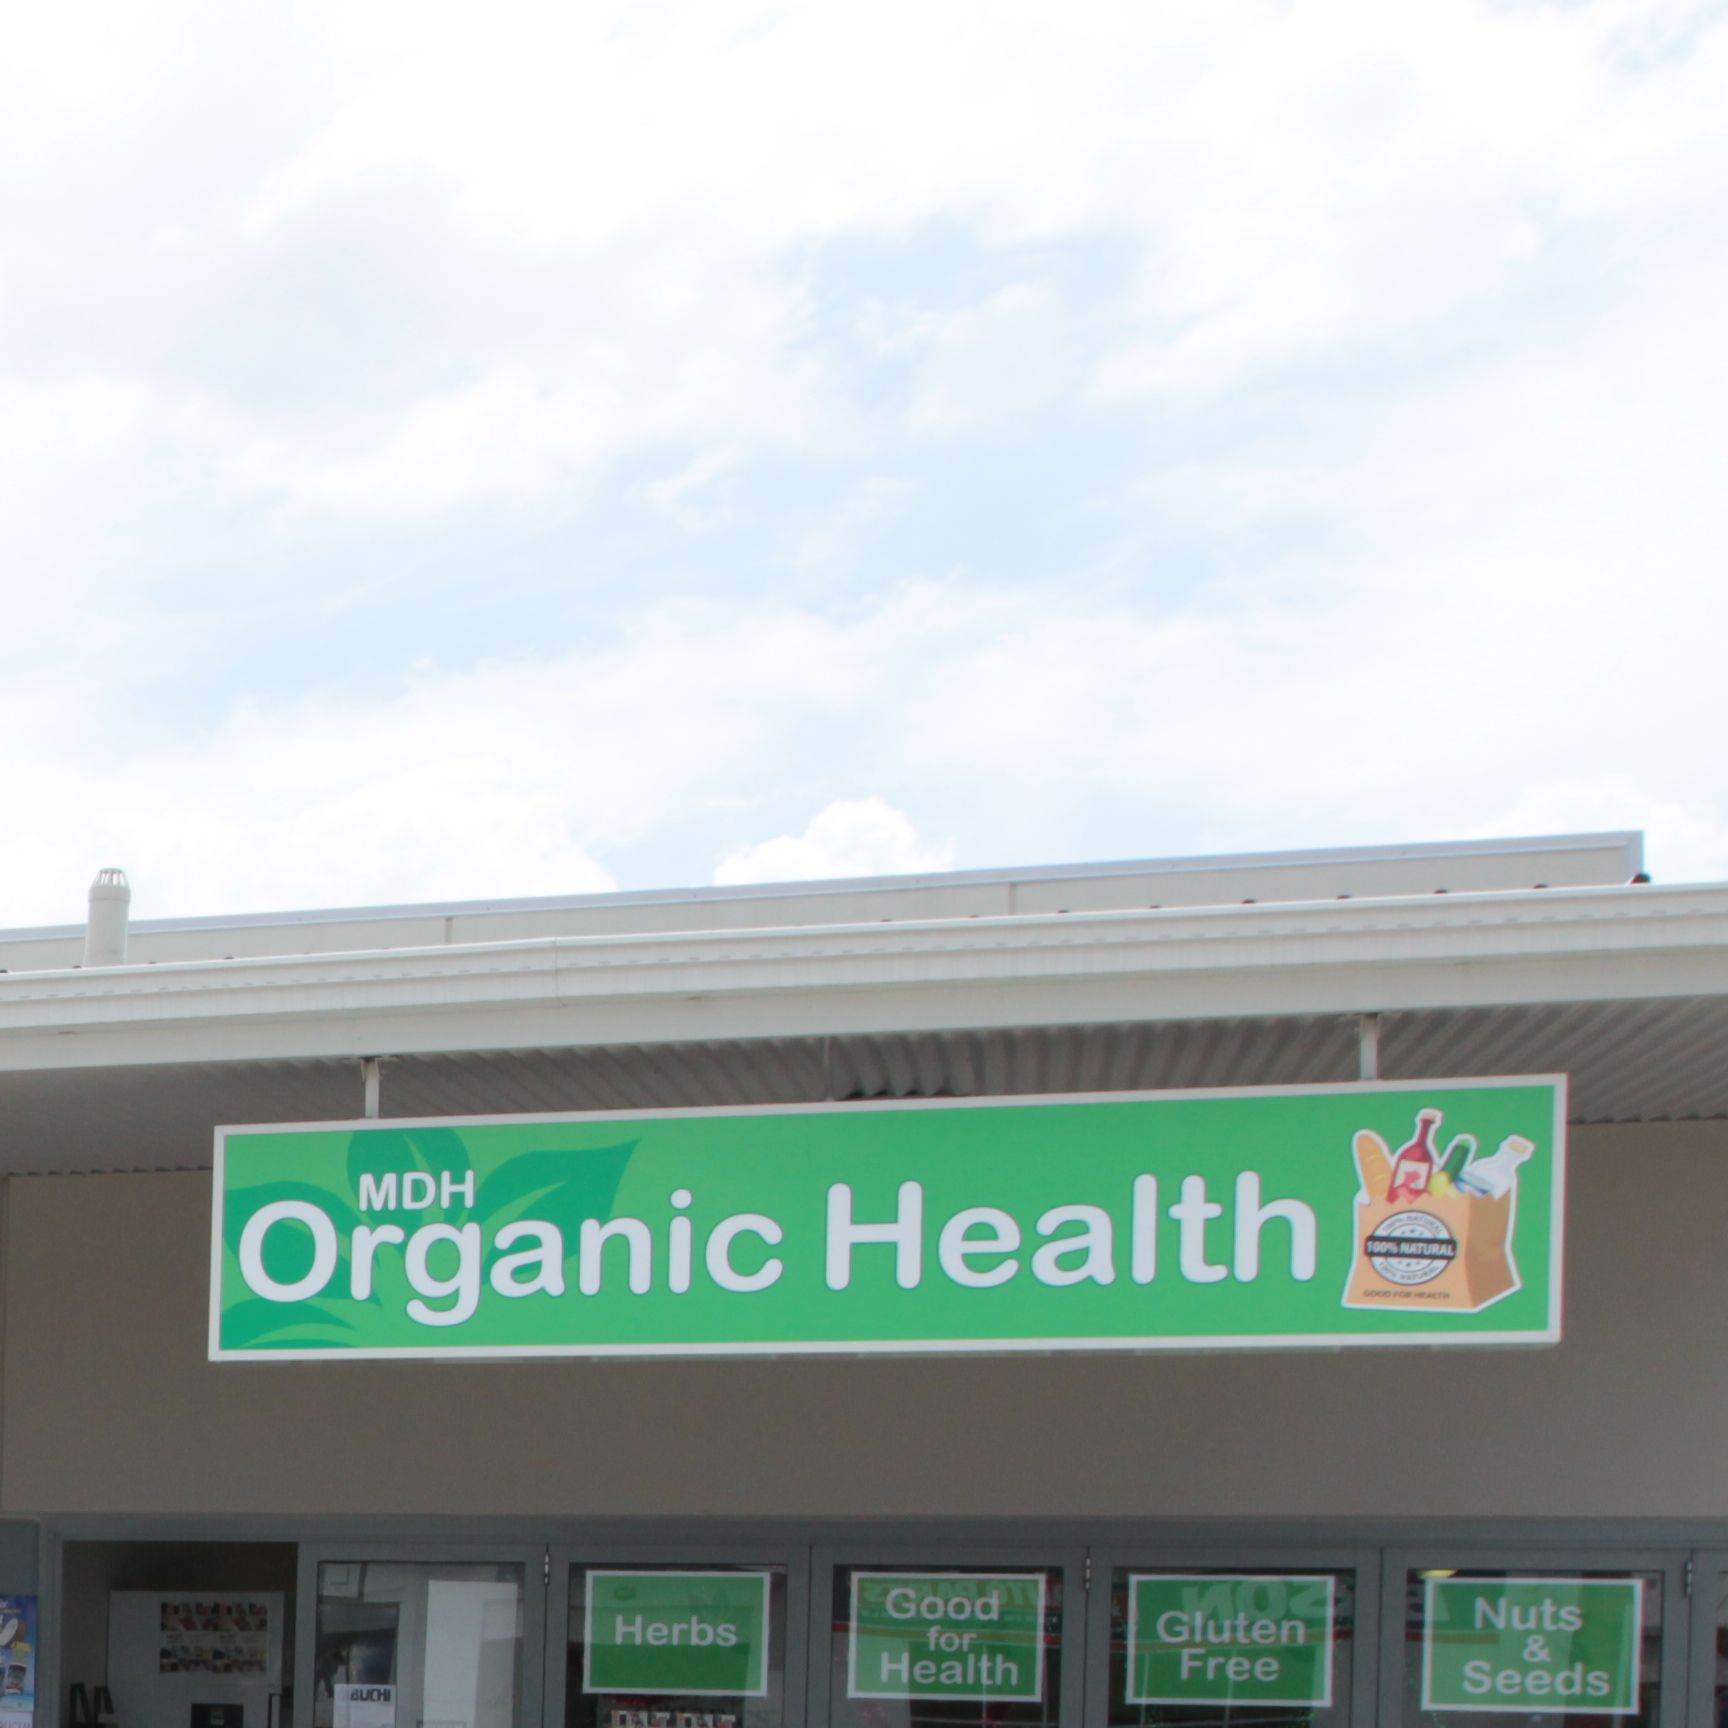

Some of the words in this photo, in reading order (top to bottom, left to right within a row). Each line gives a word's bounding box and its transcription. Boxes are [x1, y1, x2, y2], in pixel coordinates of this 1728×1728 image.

[359, 1169, 475, 1212] MDH
[238, 1187, 783, 1326] Organic
[825, 1170, 1316, 1290] Health
[1367, 1241, 1398, 1254] 100%
[1400, 1242, 1454, 1256] NATURAL
[1363, 1289, 1391, 1298] GOOD
[1414, 1290, 1450, 1299] HEALTH
[885, 1587, 1000, 1622] Good
[1474, 1597, 1583, 1632] Nuts
[614, 1614, 737, 1648] Herbs
[926, 1625, 976, 1653] for
[1156, 1610, 1305, 1645] Gluten
[1180, 1648, 1279, 1681] Free
[1522, 1635, 1551, 1663] &
[879, 1651, 1019, 1688] Health
[1463, 1659, 1611, 1698] Seeds
